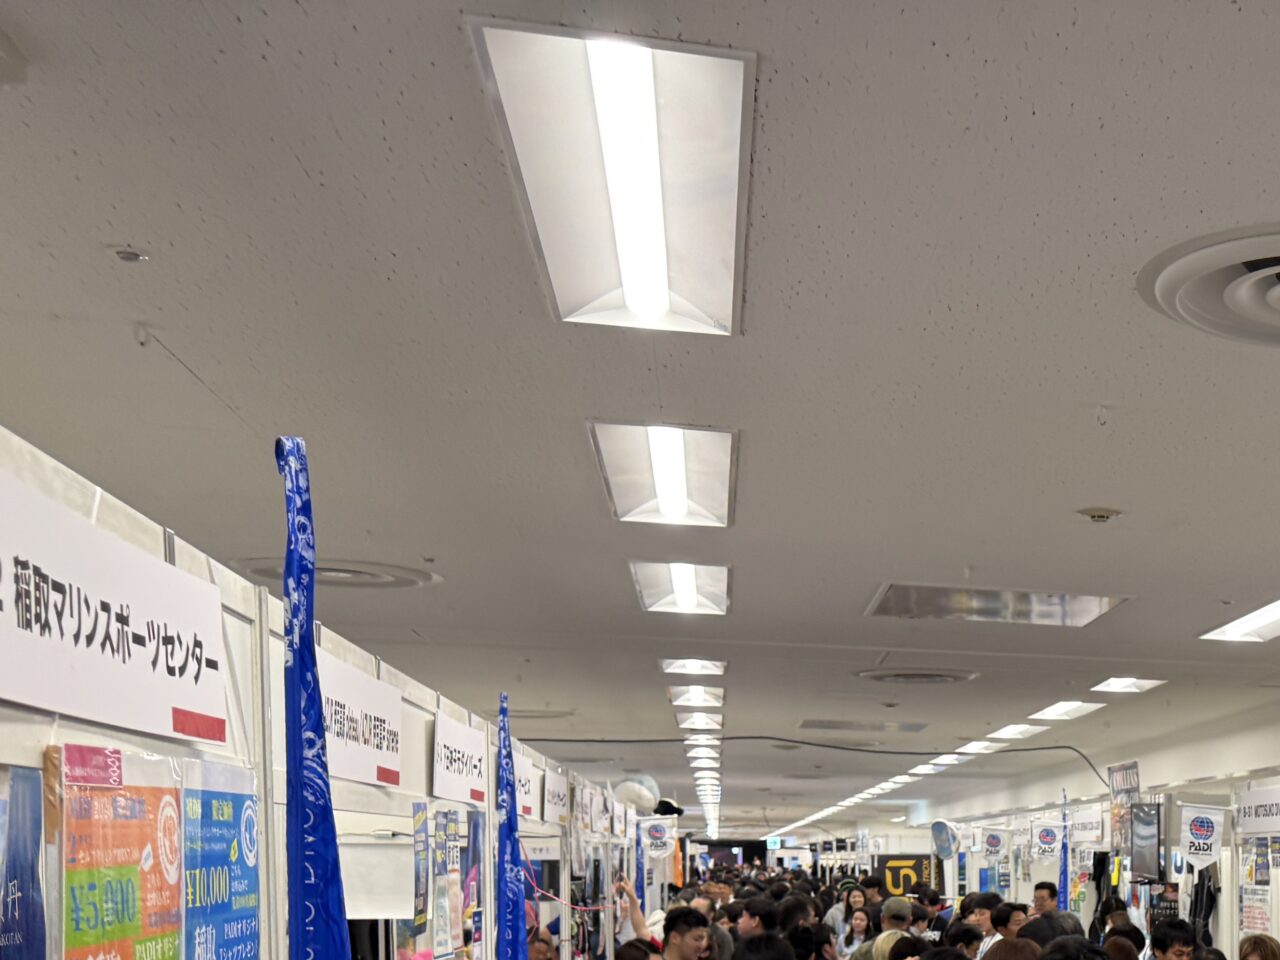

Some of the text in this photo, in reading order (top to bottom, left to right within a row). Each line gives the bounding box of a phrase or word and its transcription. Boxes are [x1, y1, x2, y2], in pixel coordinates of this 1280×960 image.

[13, 555, 219, 685] 稲取マリンスポーツセンター
[1188, 841, 1213, 852] PADI
[186, 865, 229, 911] ¥10,000
